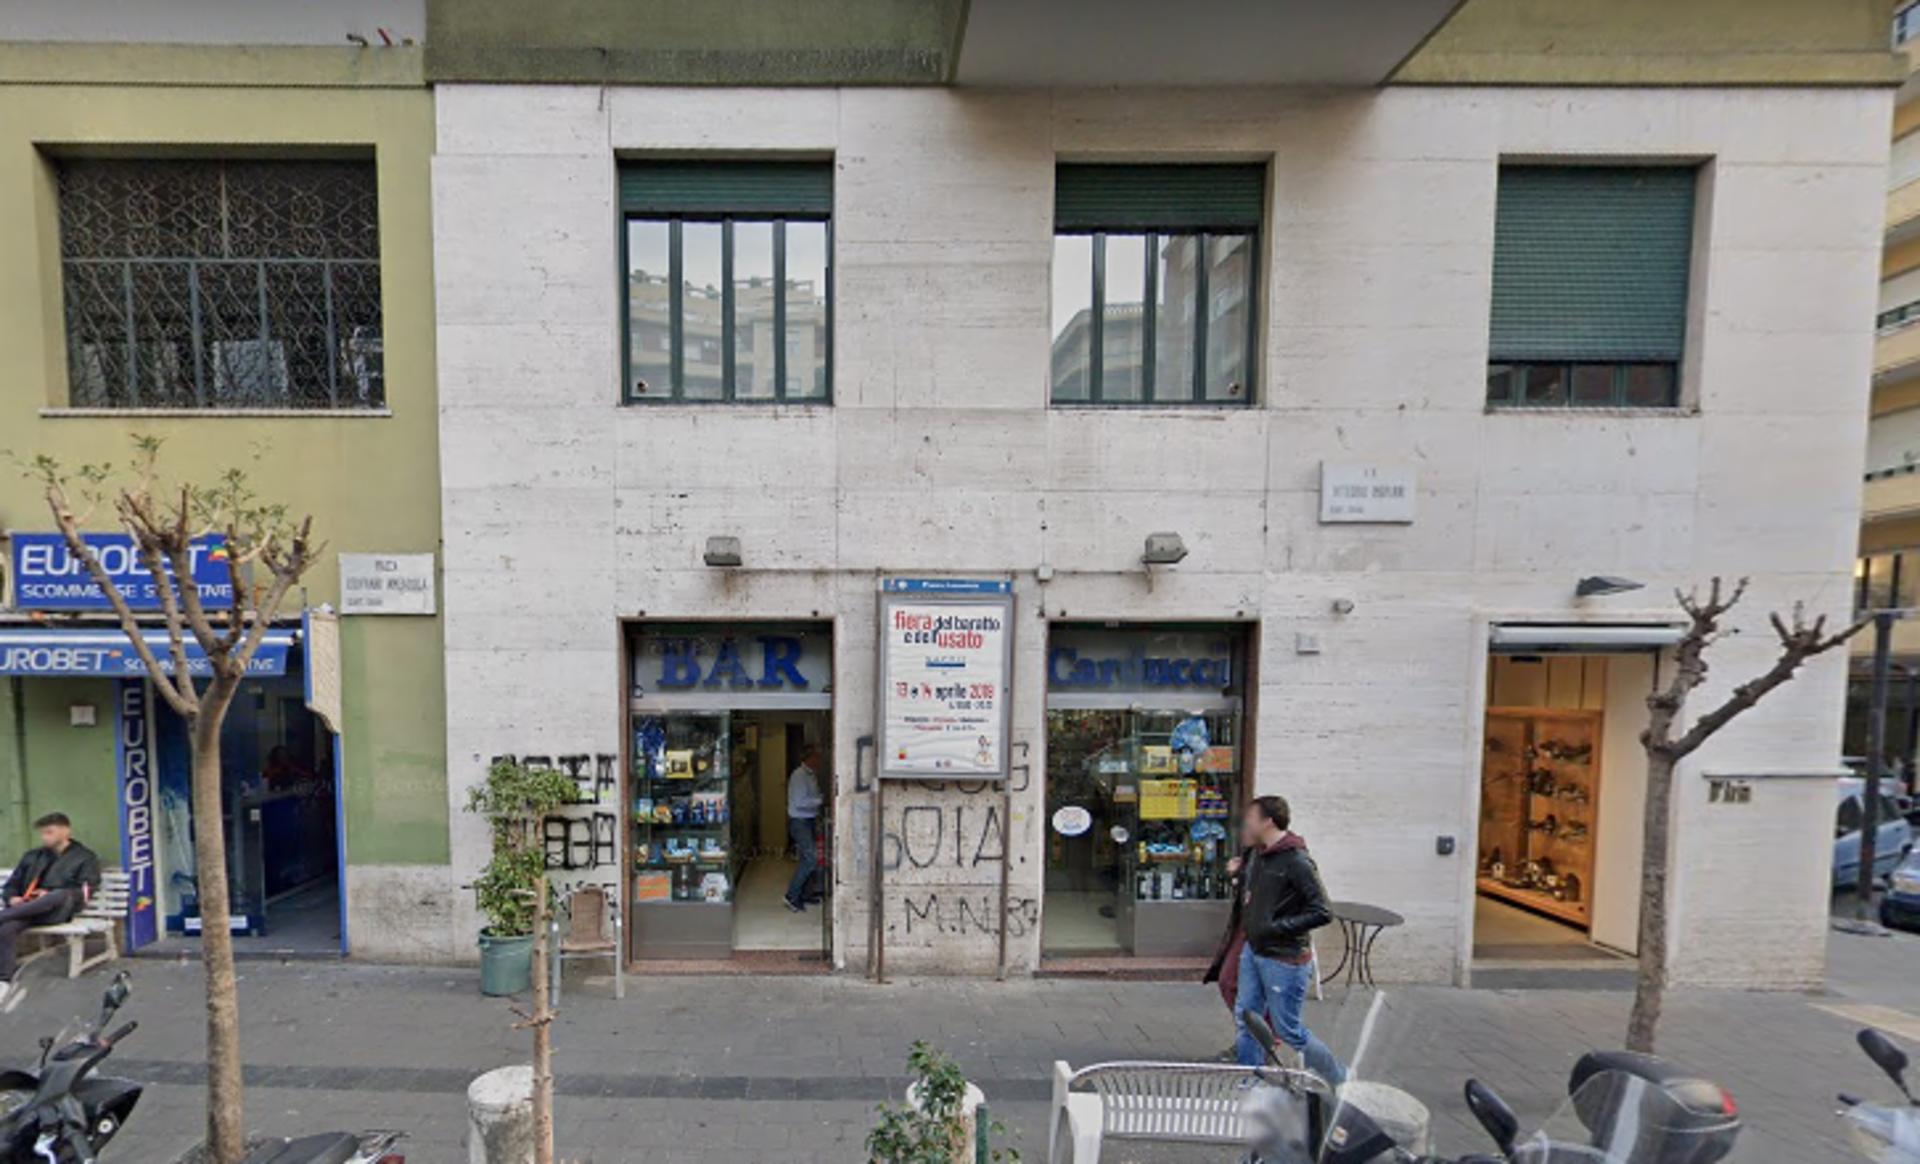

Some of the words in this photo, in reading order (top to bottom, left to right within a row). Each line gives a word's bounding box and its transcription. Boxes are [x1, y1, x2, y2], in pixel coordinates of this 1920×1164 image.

[21, 584, 138, 599] SCOMMESE
[895, 610, 932, 630] fiera
[954, 616, 1001, 631] baratto
[655, 636, 809, 687] BAR
[1050, 640, 1230, 687] Carducci
[935, 682, 966, 702] aprile
[122, 687, 154, 892] EUROBET
